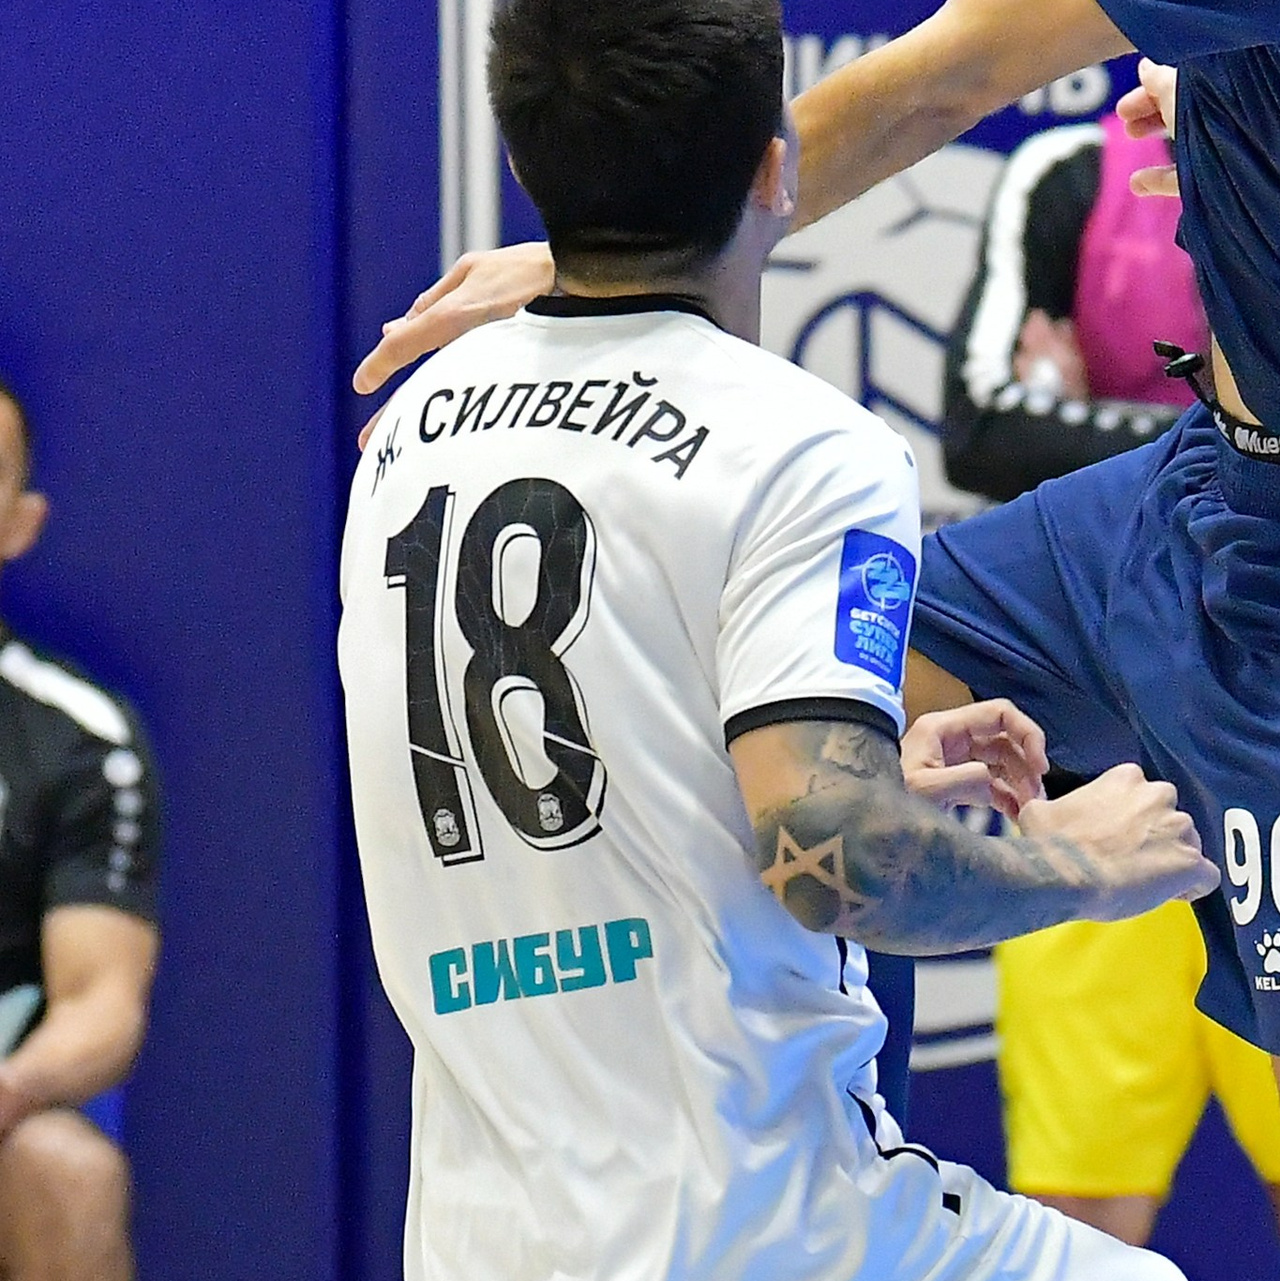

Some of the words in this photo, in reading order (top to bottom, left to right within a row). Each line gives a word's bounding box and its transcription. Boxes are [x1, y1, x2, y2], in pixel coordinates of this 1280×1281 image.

[418, 371, 710, 480] СИЛВЕЙРА
[384, 477, 607, 867] 18
[428, 916, 654, 1015] СИБУР
